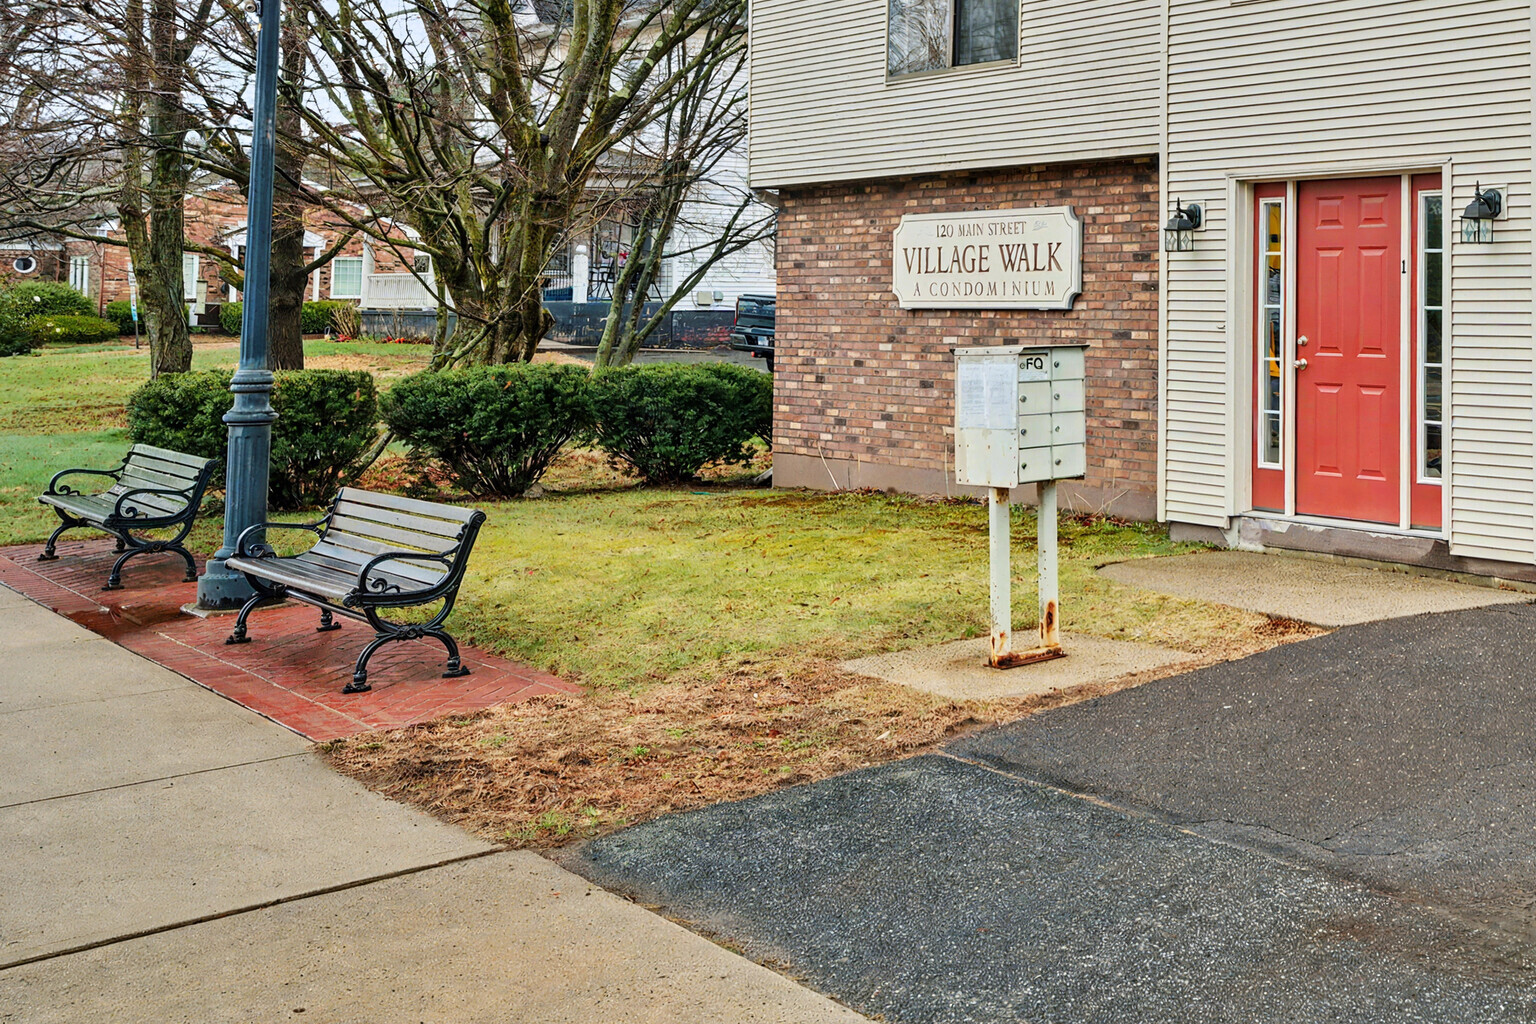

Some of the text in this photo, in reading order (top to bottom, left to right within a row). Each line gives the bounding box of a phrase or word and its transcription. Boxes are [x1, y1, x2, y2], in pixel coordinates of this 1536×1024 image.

[936, 224, 954, 238] 120
[958, 223, 984, 237] MAIN
[988, 221, 1027, 236] STREET
[903, 242, 1063, 274] VILLAGE WALK
[1402, 260, 1406, 273] 1
[913, 281, 1055, 296] A CONDOMINIUM
